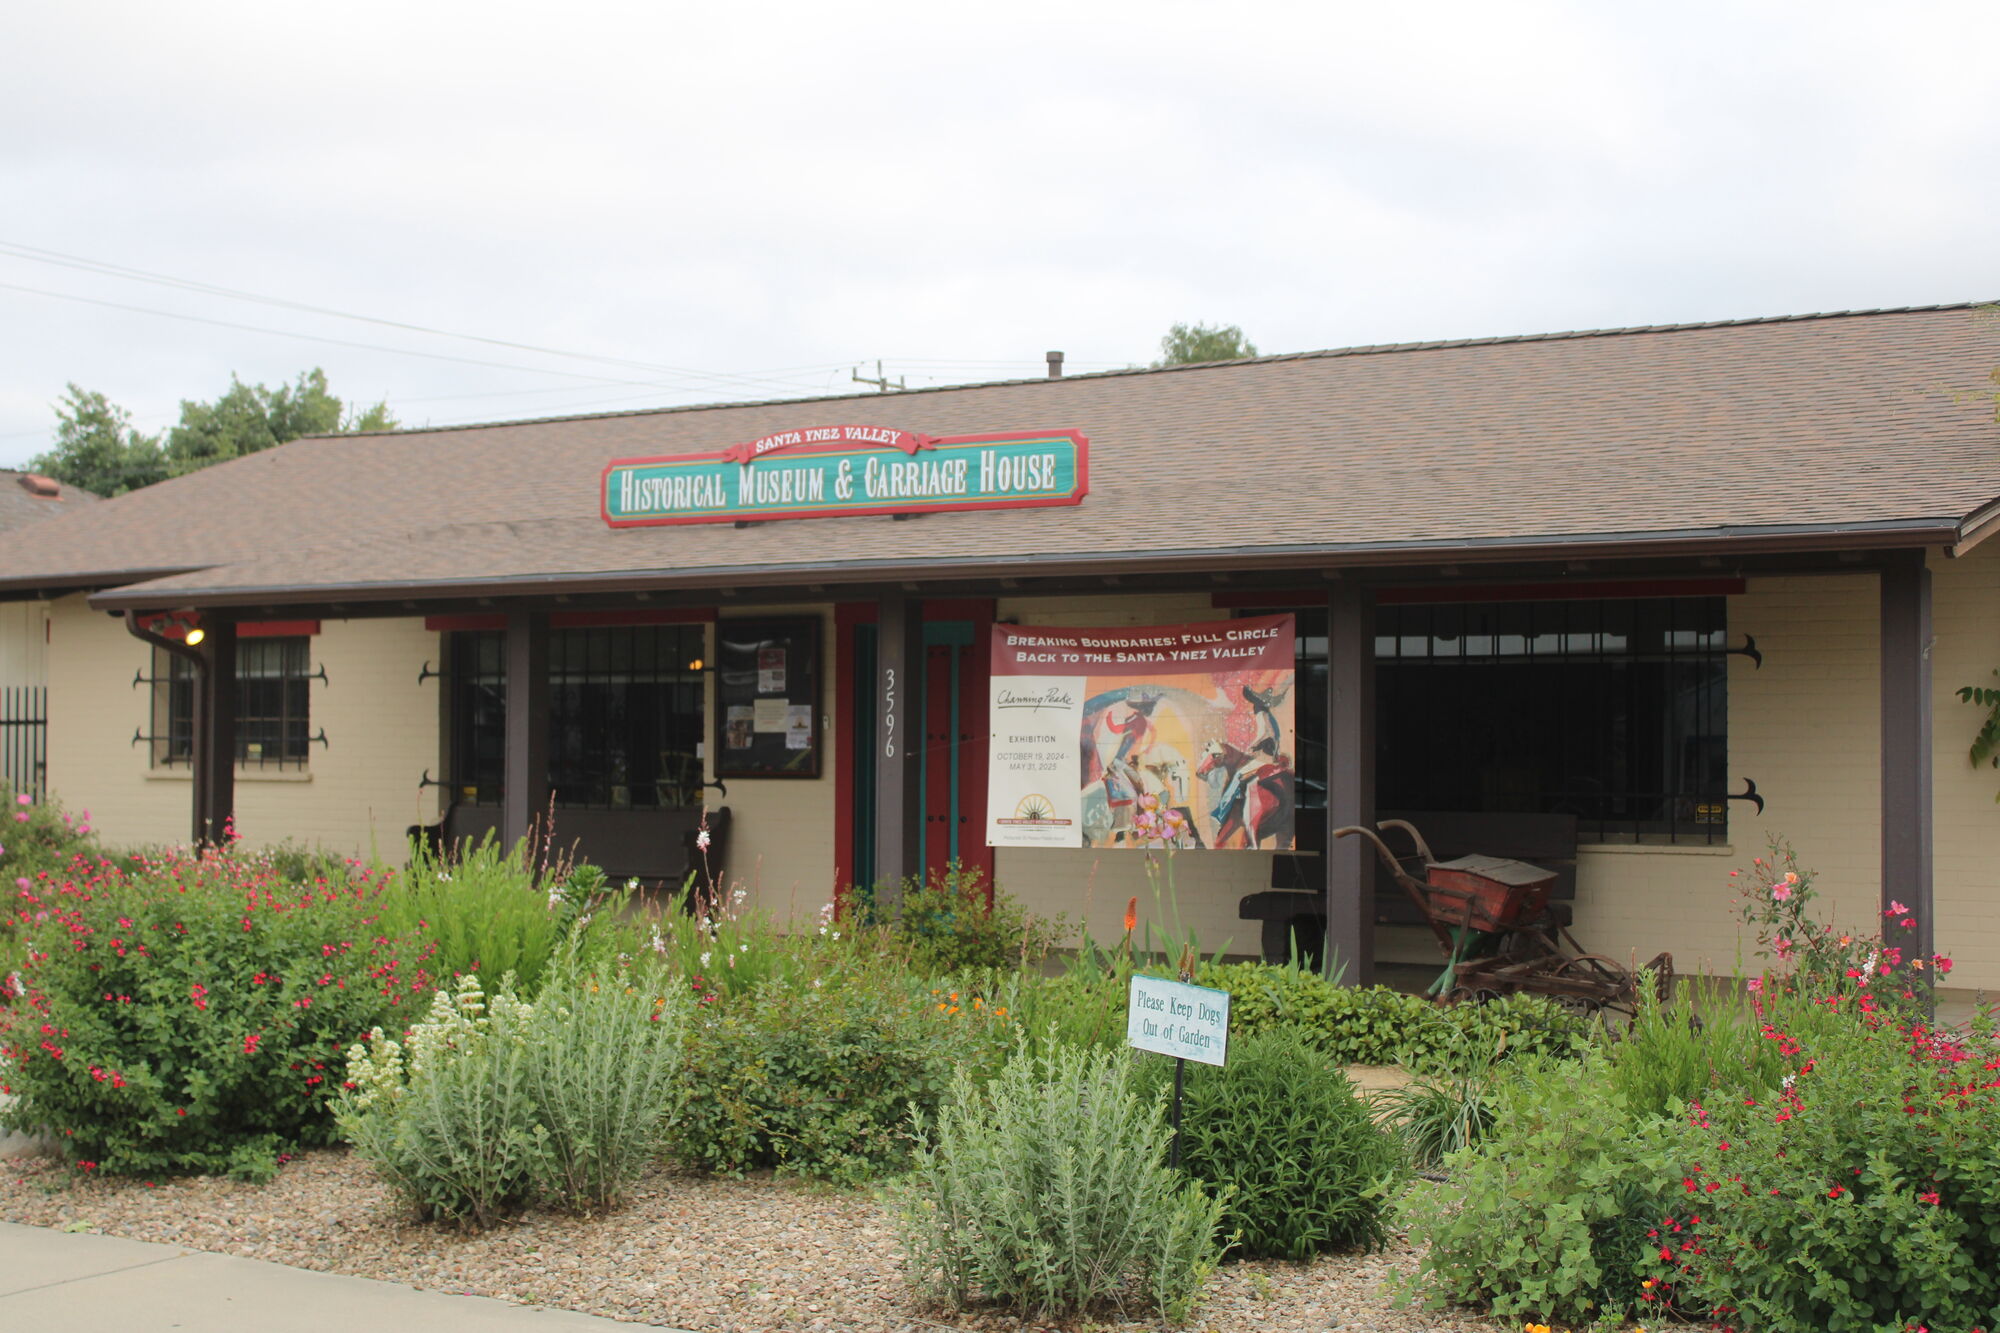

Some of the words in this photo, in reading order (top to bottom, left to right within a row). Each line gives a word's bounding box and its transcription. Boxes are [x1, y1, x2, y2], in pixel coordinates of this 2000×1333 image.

[755, 431, 801, 453] SANTA
[805, 428, 840, 442] YNEZ
[844, 427, 901, 445] VALLEY
[620, 470, 726, 512] HISTORICAL
[738, 465, 825, 506] MUSEUM
[834, 459, 853, 499] &
[864, 457, 967, 498] CARRIAGE
[980, 450, 1055, 492] HOUSE
[1007, 635, 1078, 647] BREAKING
[1081, 637, 1177, 648] BOUNDARIES:
[1181, 634, 1222, 644] FULL
[1226, 628, 1279, 641] CIRCLE
[1016, 651, 1057, 662] BACK
[1061, 653, 1080, 663] TO
[1084, 653, 1112, 663] THE
[1116, 651, 1166, 662] SANTA
[1169, 650, 1208, 661] YNEZ
[1212, 645, 1266, 659] VALLEY
[886, 668, 895, 757] 3596
[1009, 735, 1056, 743] EXHIBITION
[997, 752, 1033, 761] OCTOBER
[1046, 752, 1065, 761] 2024
[1009, 762, 1026, 771] MAY
[1038, 762, 1057, 771] 2025
[1137, 990, 1165, 1012] Please
[1170, 997, 1193, 1021] Keep
[1199, 1003, 1221, 1026] Dogs
[1143, 1018, 1158, 1037] Out
[1163, 1024, 1174, 1040] of
[1179, 1026, 1210, 1048] Garden
